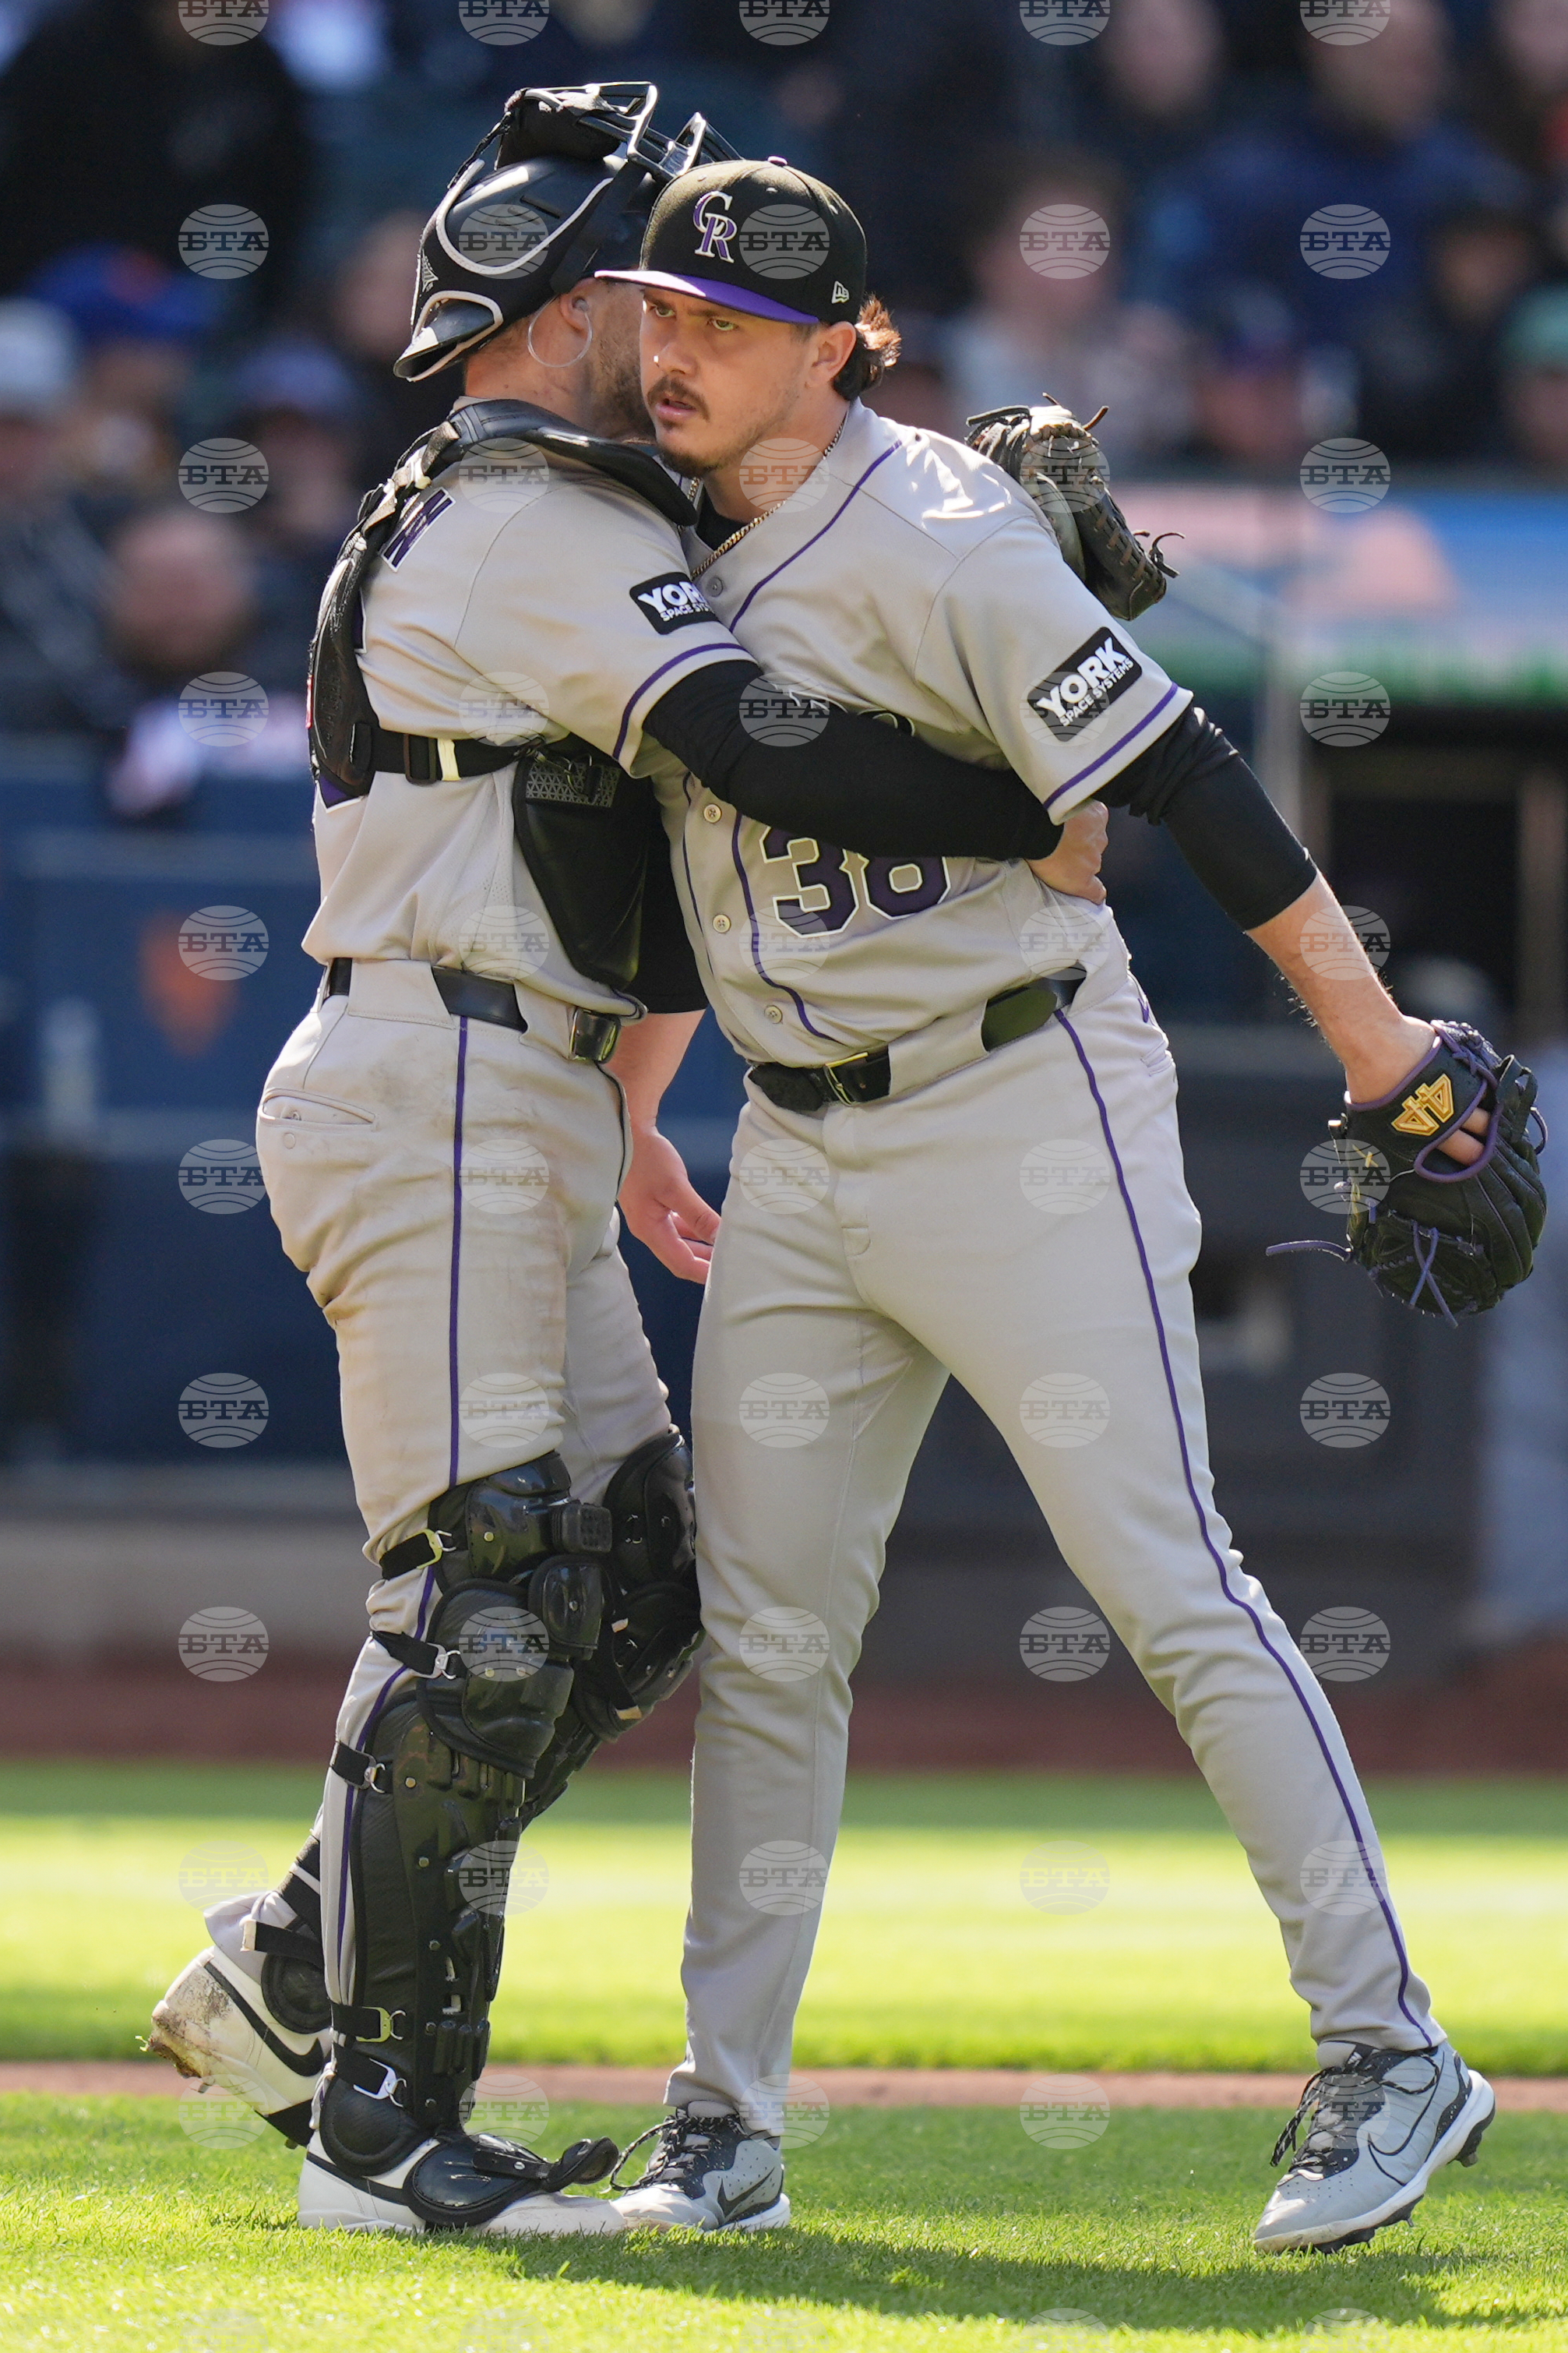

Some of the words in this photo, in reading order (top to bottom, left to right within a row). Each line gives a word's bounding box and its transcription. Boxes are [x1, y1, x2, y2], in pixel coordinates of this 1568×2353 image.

[661, 604, 694, 622] SPACE
[1036, 637, 1127, 718] YORK
[1059, 693, 1094, 727] SPACE
[1092, 658, 1134, 698] SYSTEMS
